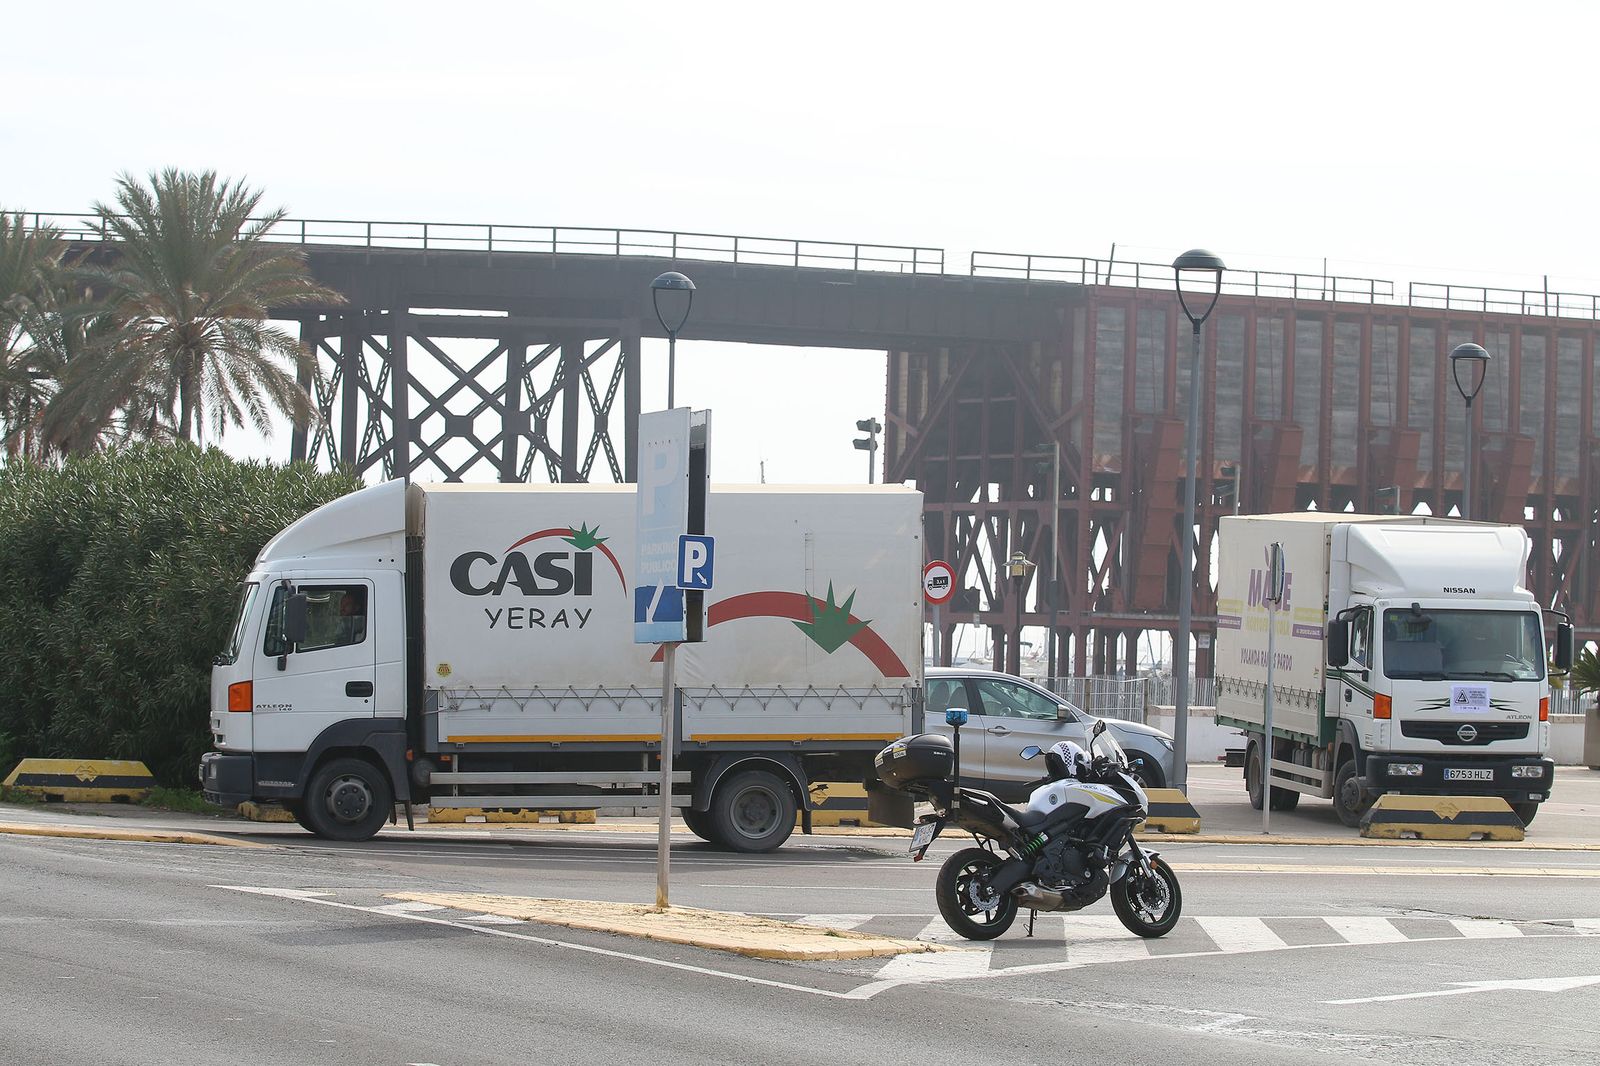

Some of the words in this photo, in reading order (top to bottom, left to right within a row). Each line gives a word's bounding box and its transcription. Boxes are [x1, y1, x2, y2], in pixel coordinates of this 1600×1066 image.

[449, 551, 593, 596] CASI
[683, 541, 708, 583] P
[1248, 569, 1292, 611] MAE
[484, 607, 593, 630] YERAY
[1261, 650, 1277, 668] RAS
[1450, 770, 1473, 779] 6753
[1474, 770, 1492, 780] HLZ
